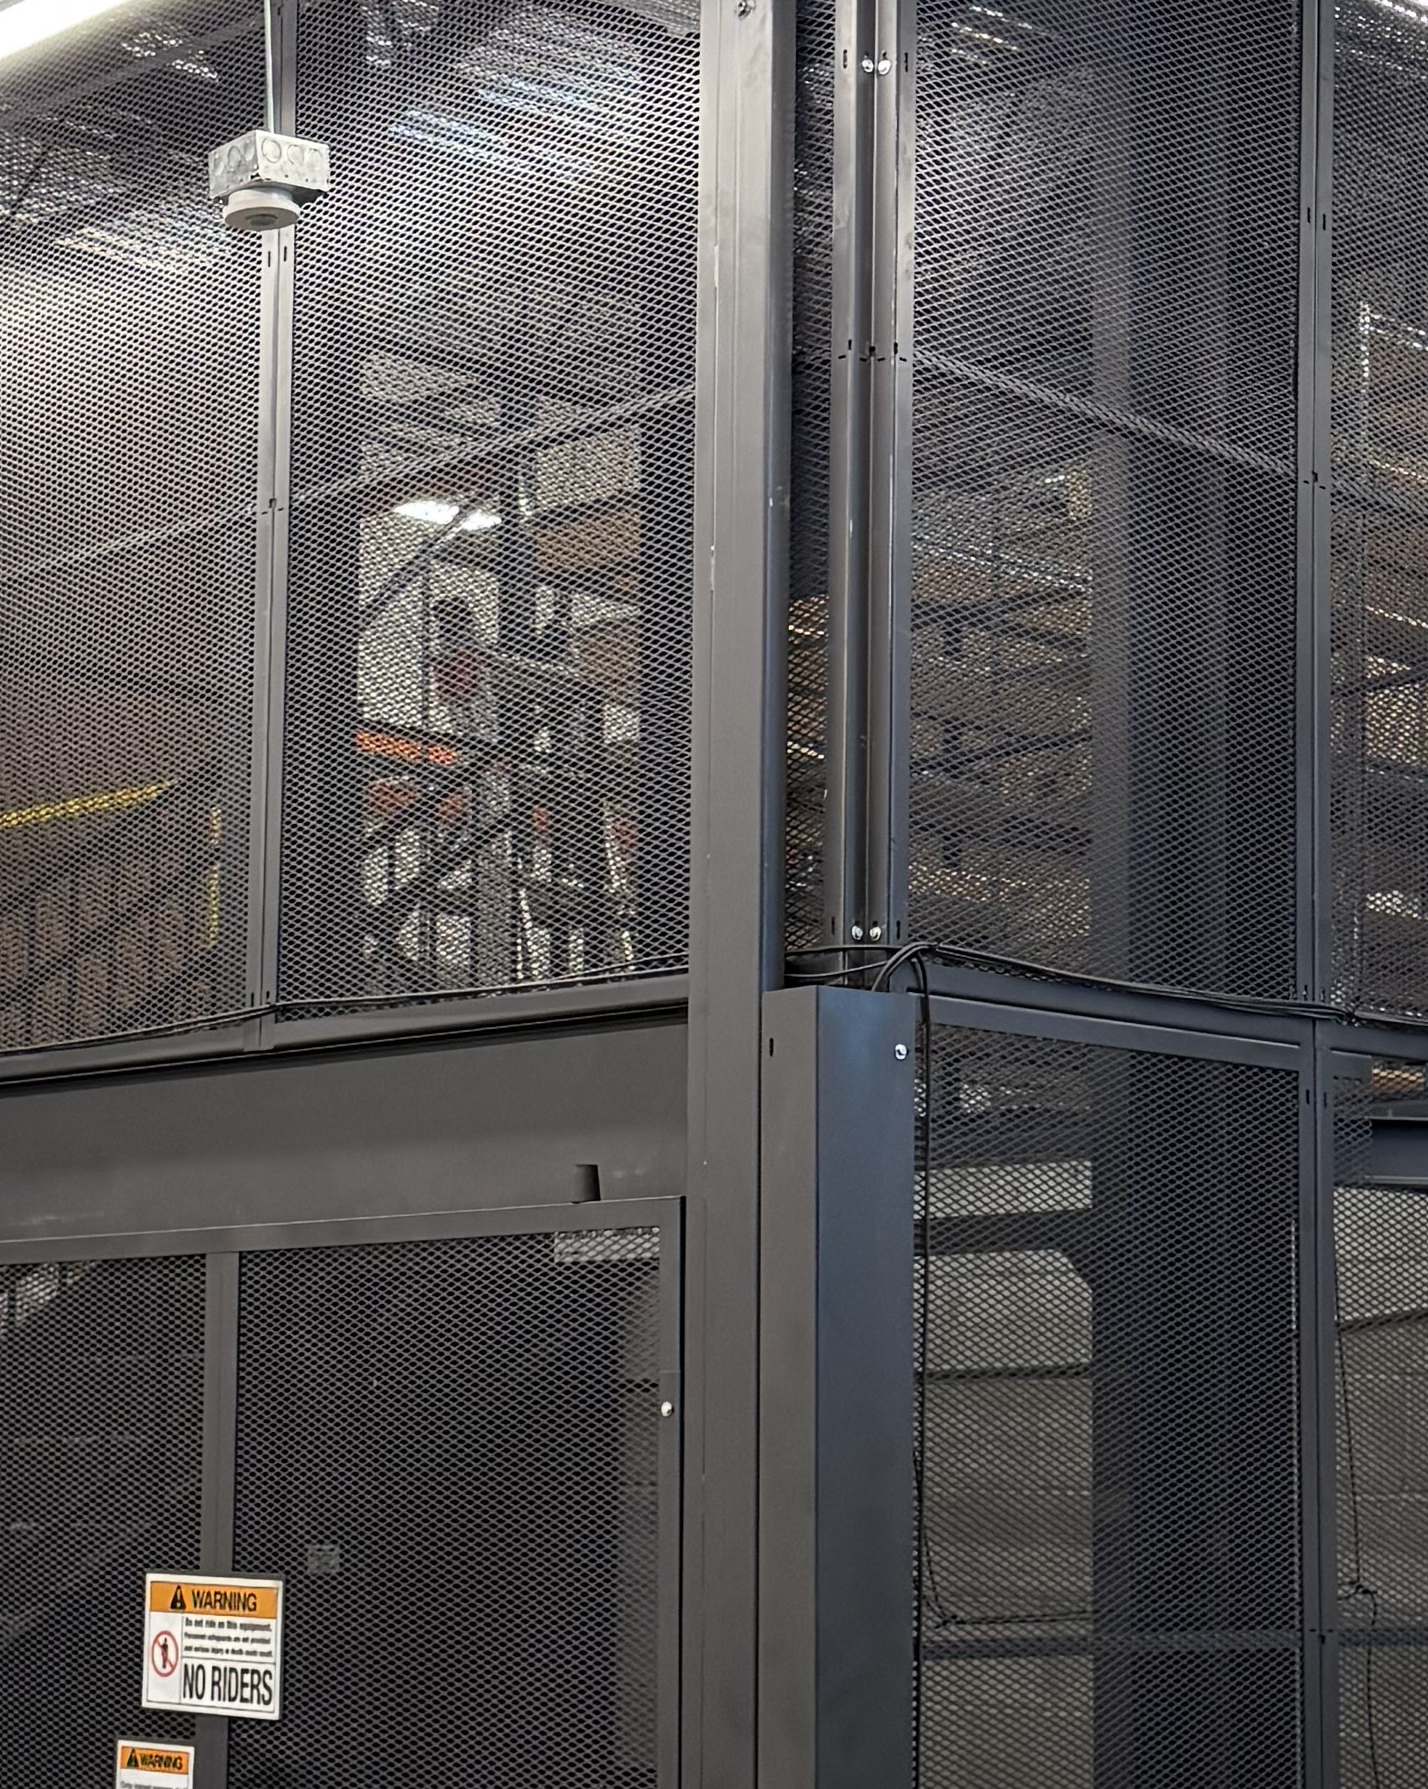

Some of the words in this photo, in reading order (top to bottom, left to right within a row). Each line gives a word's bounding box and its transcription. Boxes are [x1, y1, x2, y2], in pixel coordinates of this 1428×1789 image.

[191, 1589, 257, 1612] WARNING
[183, 1663, 206, 1700] NO
[211, 1665, 273, 1706] RIDERS
[140, 1753, 183, 1771] WARNING
